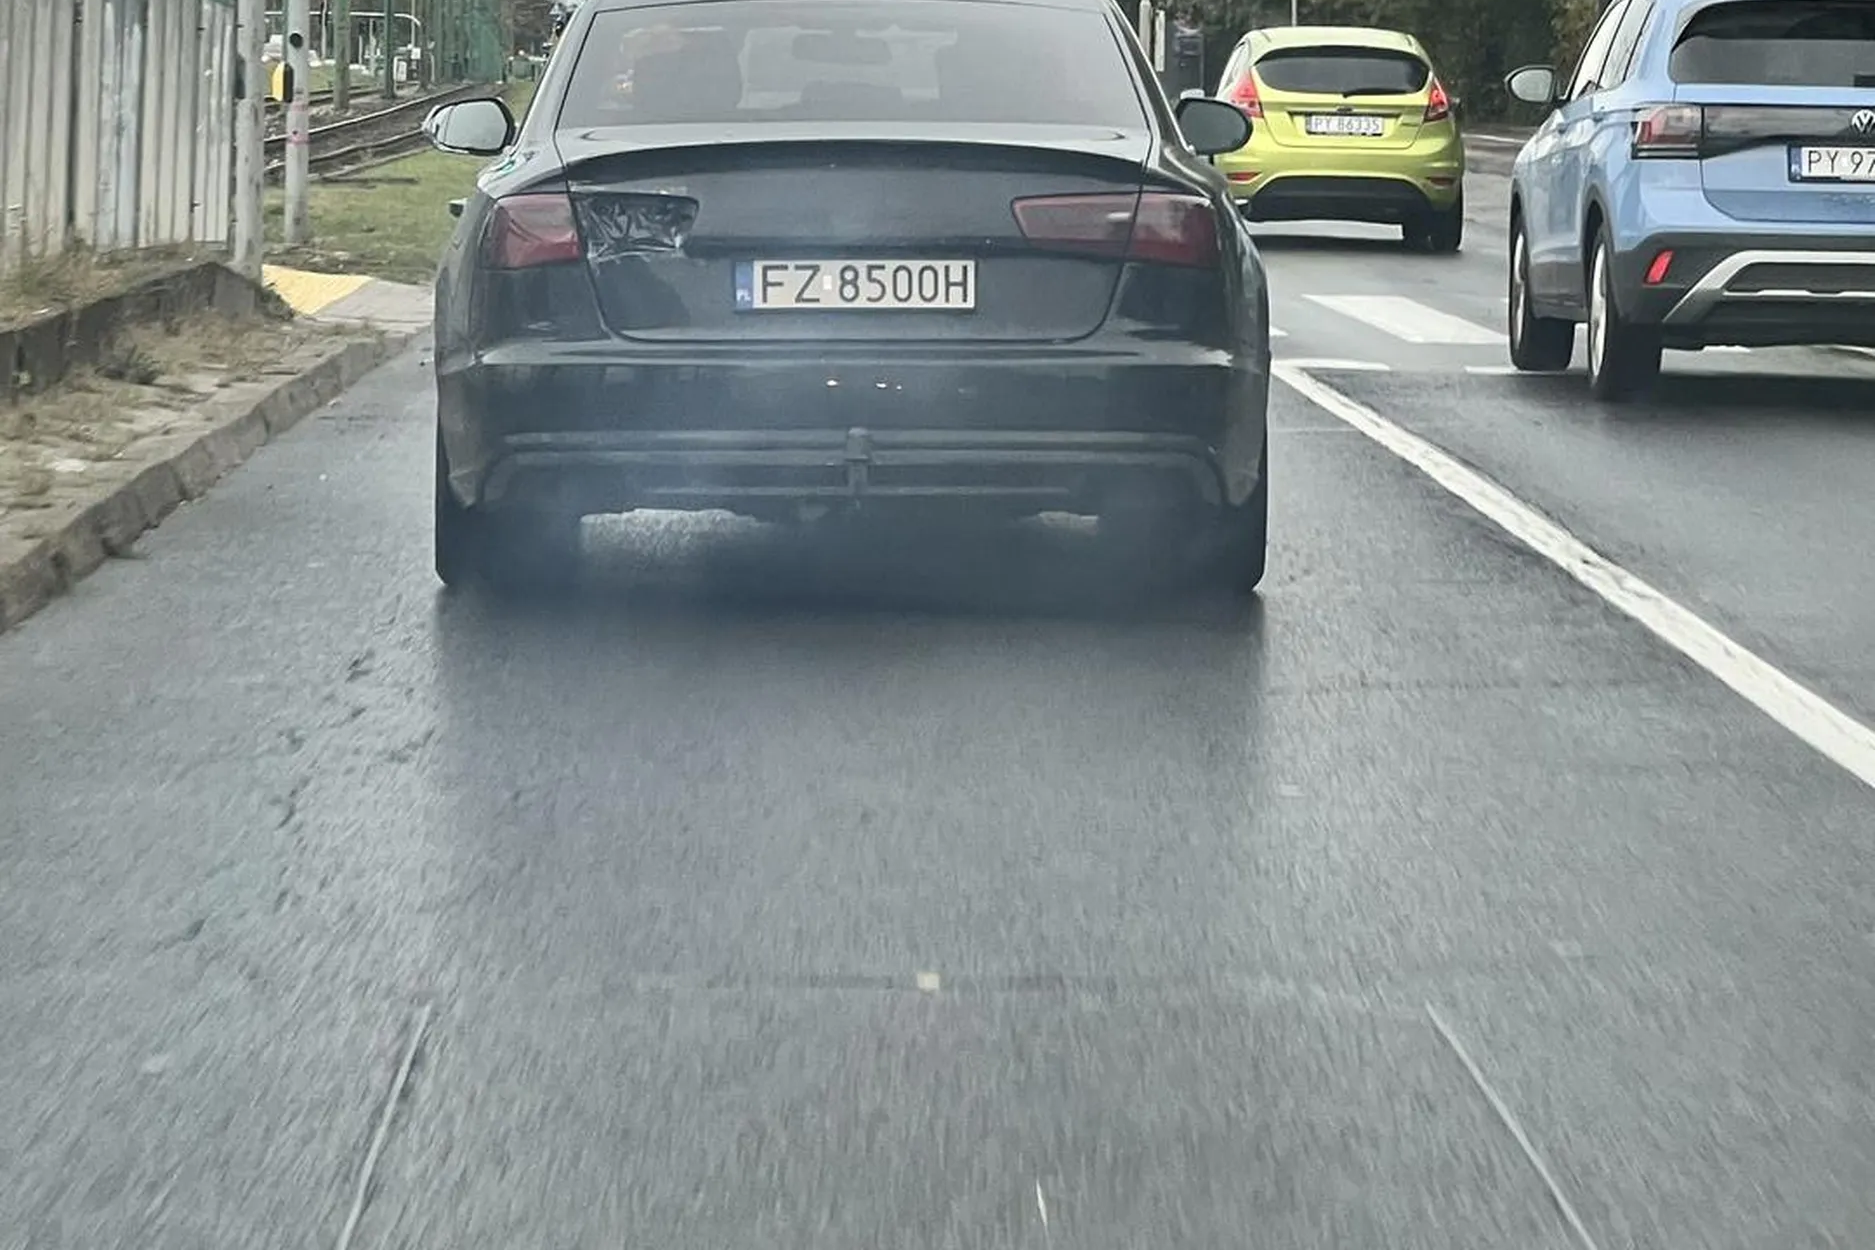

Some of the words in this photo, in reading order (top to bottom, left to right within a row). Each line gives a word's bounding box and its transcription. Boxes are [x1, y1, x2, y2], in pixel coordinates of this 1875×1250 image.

[1314, 117, 1332, 130] PY
[1808, 150, 1839, 173] PY
[761, 264, 821, 303] FZ
[838, 264, 969, 303] 8500H
